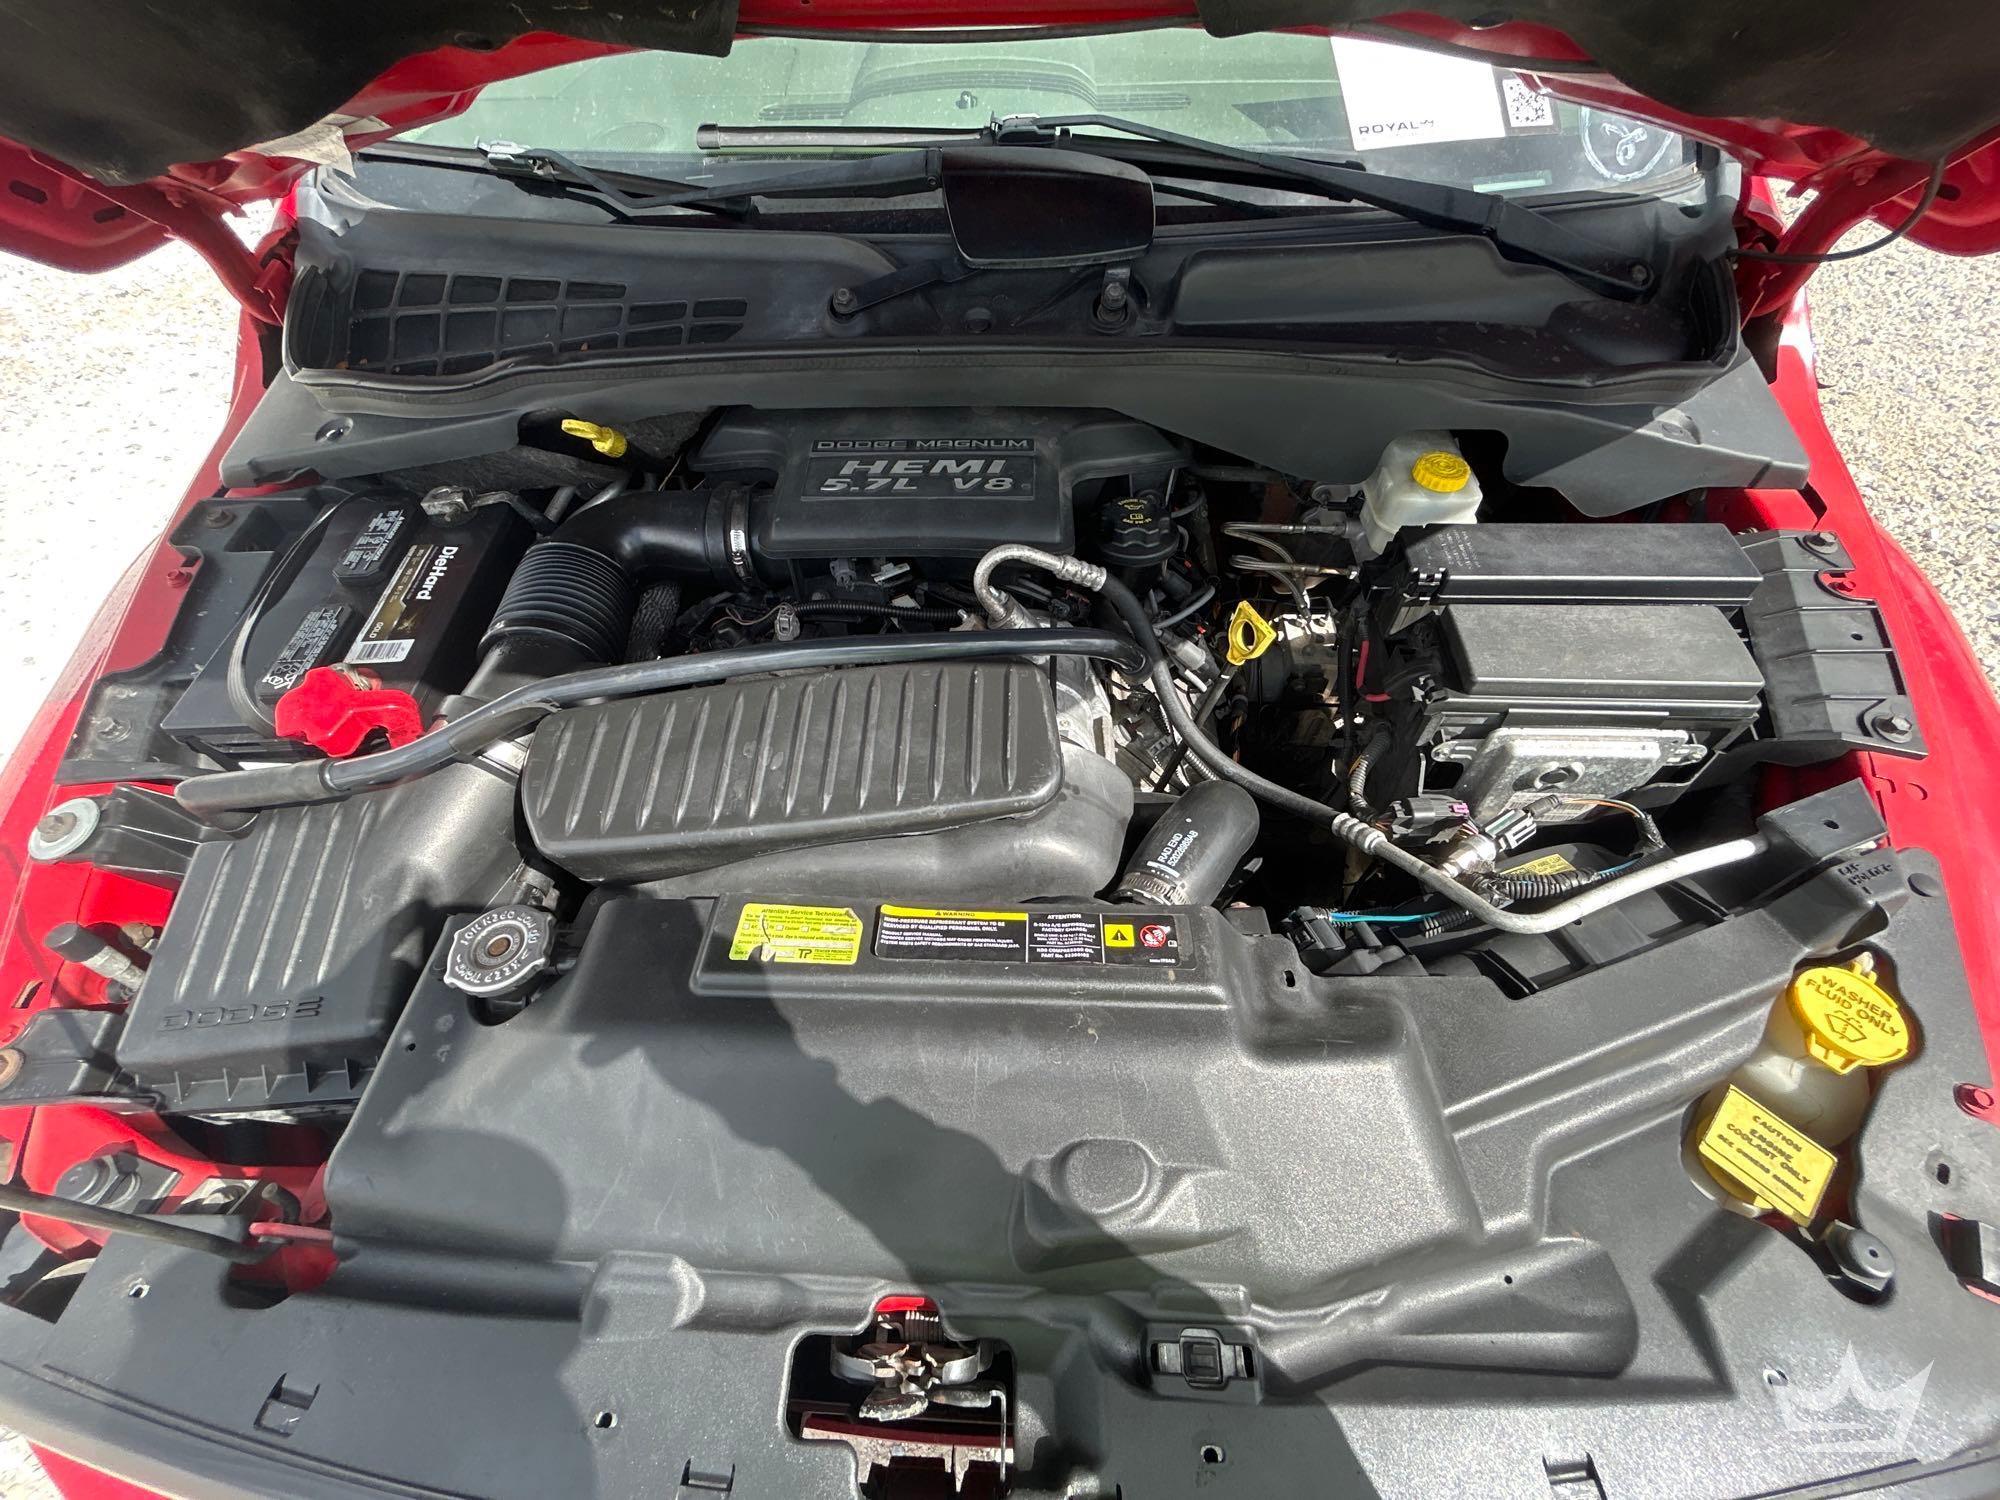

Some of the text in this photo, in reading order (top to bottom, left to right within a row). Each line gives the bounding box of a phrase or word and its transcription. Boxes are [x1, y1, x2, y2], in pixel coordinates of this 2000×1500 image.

[1359, 121, 1419, 135] ROYAL
[817, 439, 1028, 449] DODGE MAGNUM
[839, 460, 1006, 474] HEMI
[820, 478, 1013, 492] 5.7L V8
[416, 546, 458, 600] DieHard
[370, 622, 384, 638] GOLD
[1157, 833, 1183, 863] RAD END
[158, 996, 324, 1032] DODGE
[1805, 979, 1900, 1037] FLUID ONLY
[1822, 975, 1892, 1022] WASHER
[1750, 1128, 1794, 1162] ENGINE
[1752, 1115, 1802, 1152] CAUTION
[1727, 1124, 1811, 1184] COOLANT ONLY
